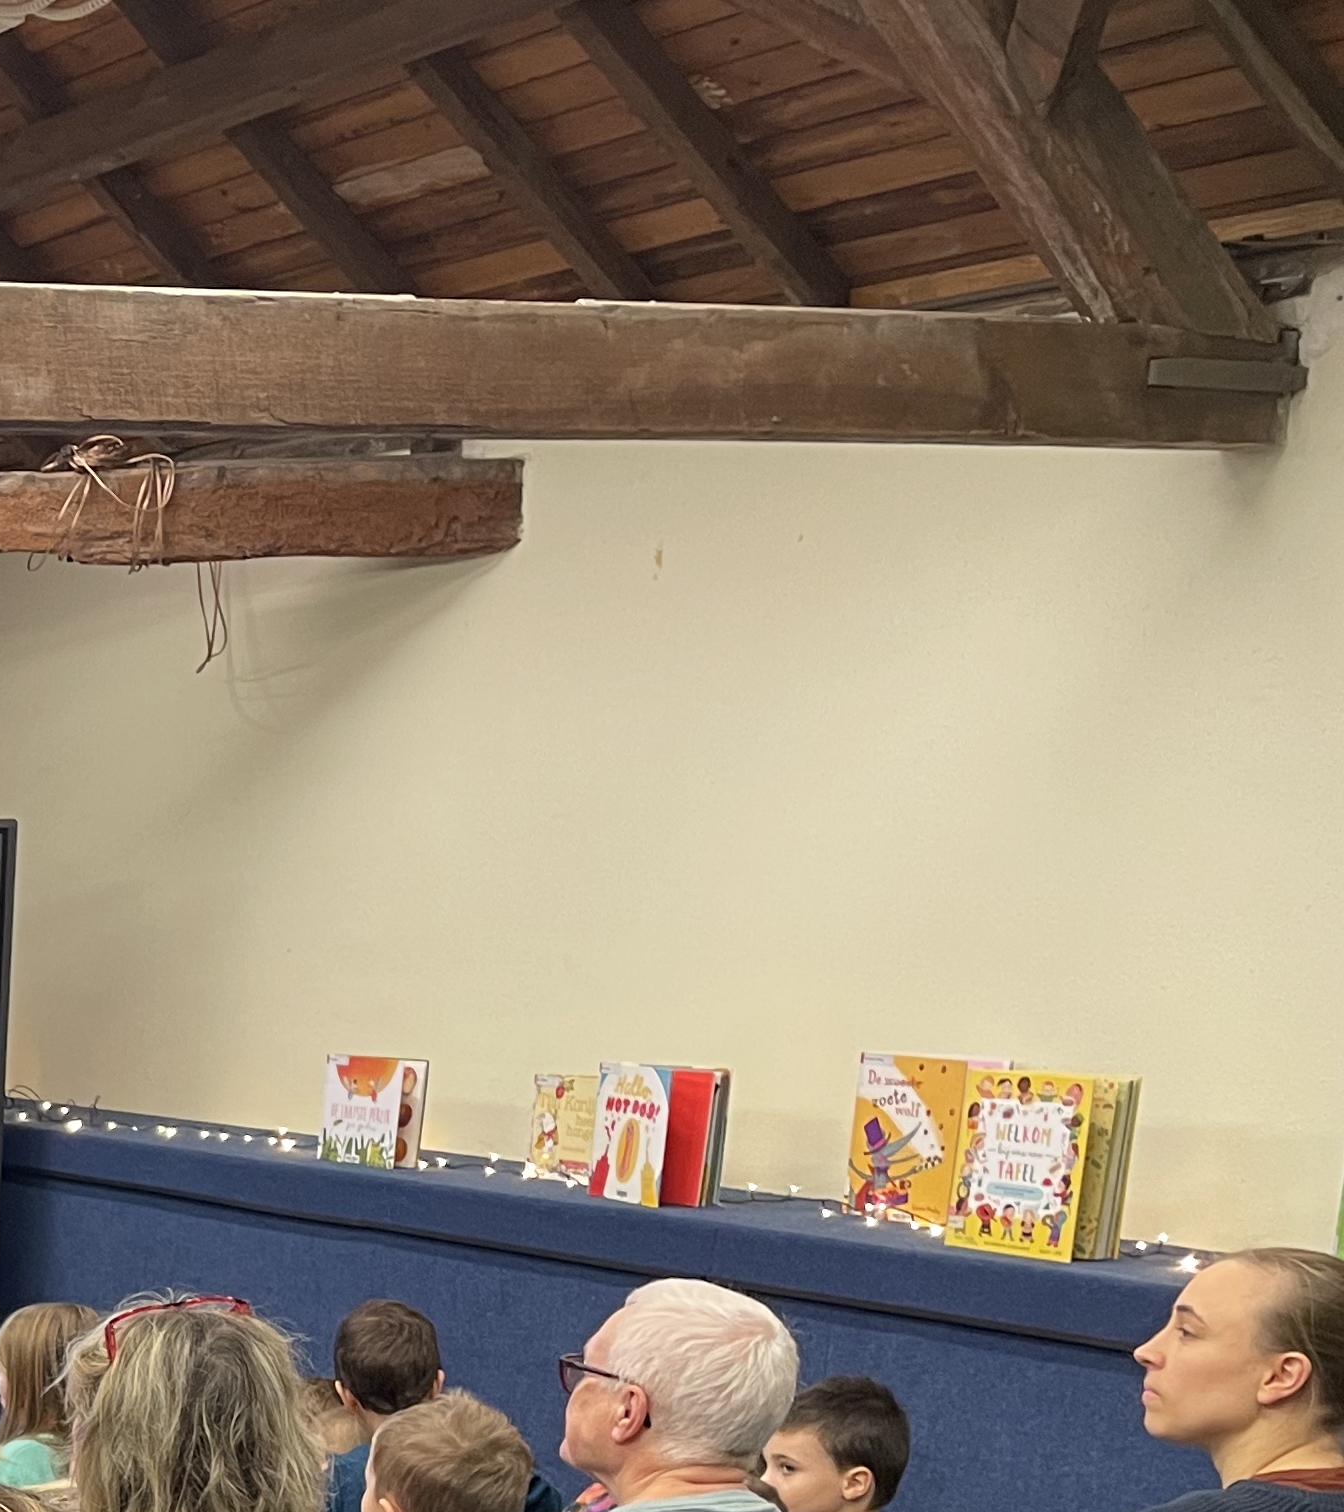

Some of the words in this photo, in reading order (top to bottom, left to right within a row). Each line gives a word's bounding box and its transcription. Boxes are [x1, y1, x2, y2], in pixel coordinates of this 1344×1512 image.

[868, 1069, 882, 1085] De
[995, 1122, 1053, 1148] WELKOM
[997, 1160, 1037, 1184] TAFEL
